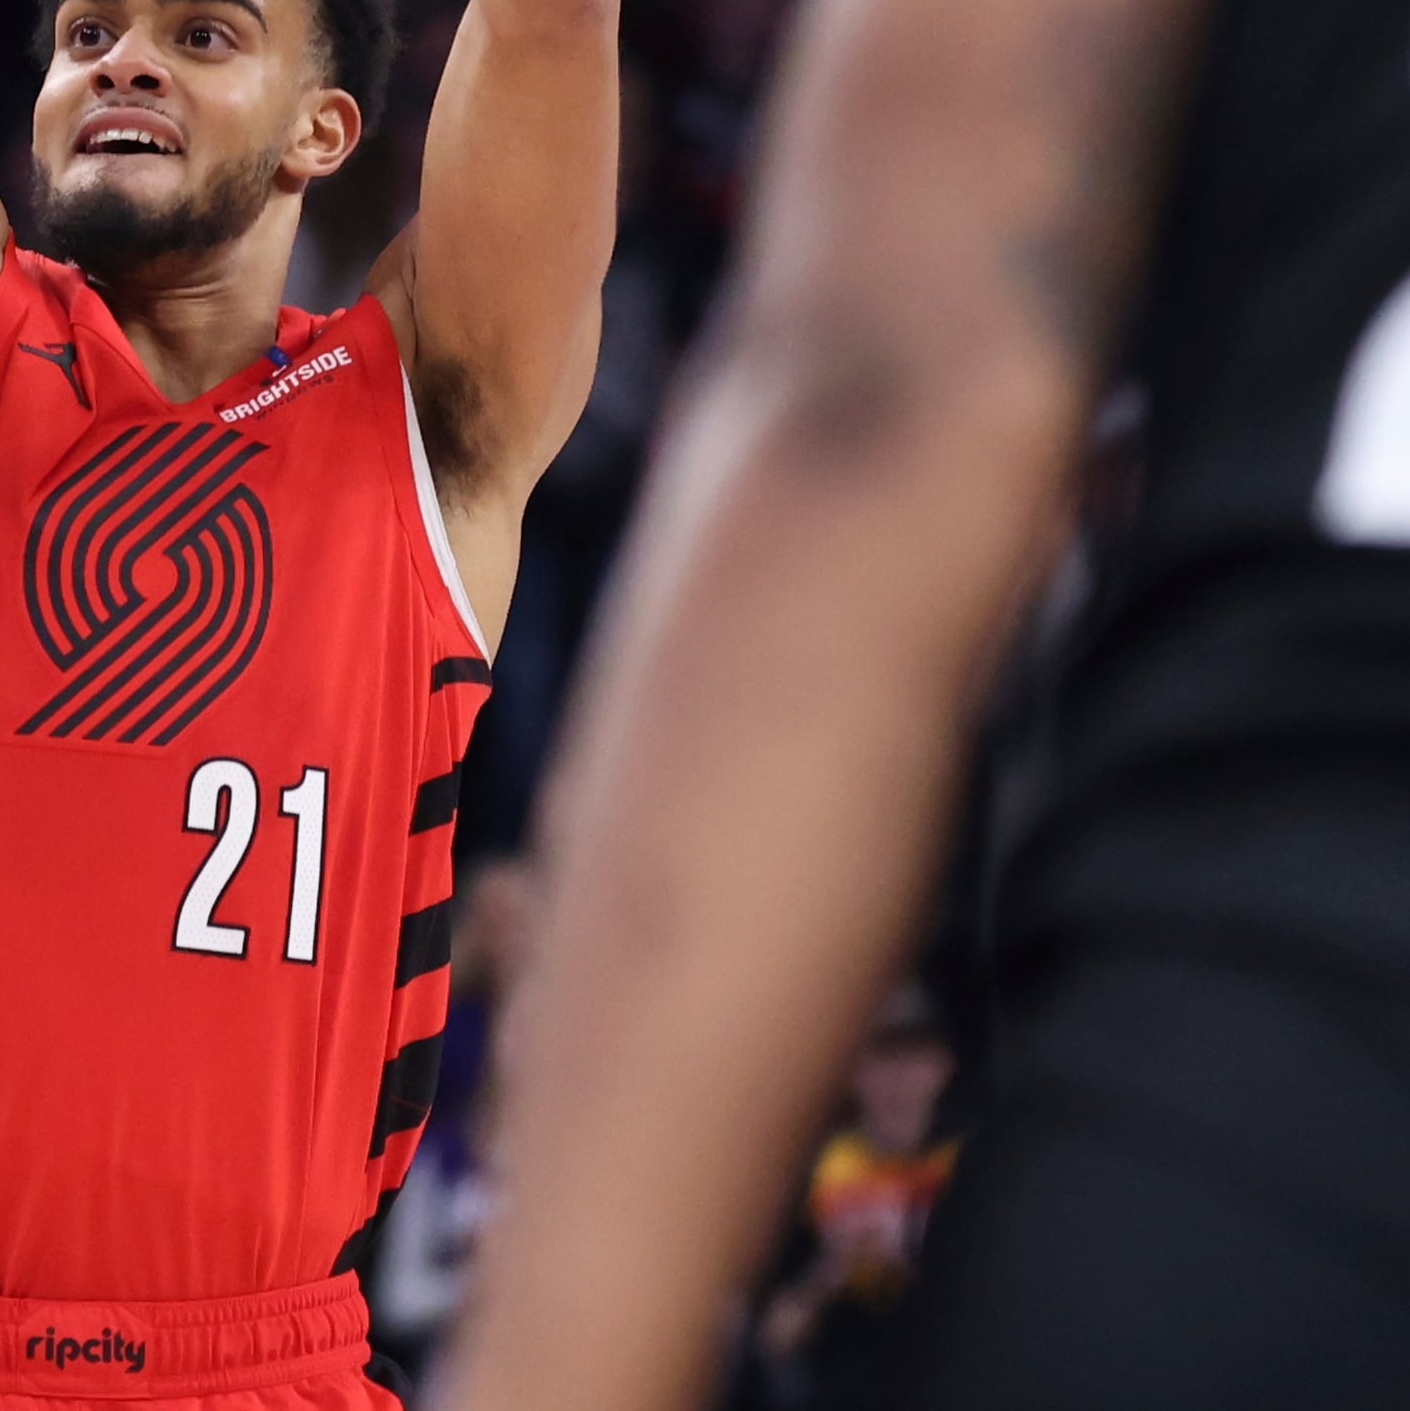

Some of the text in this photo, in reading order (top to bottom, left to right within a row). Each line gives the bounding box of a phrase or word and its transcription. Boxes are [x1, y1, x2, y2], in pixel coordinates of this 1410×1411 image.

[219, 345, 353, 423] BRIGHTSIDE
[171, 756, 330, 966] 21
[26, 1326, 146, 1374] ripcity
